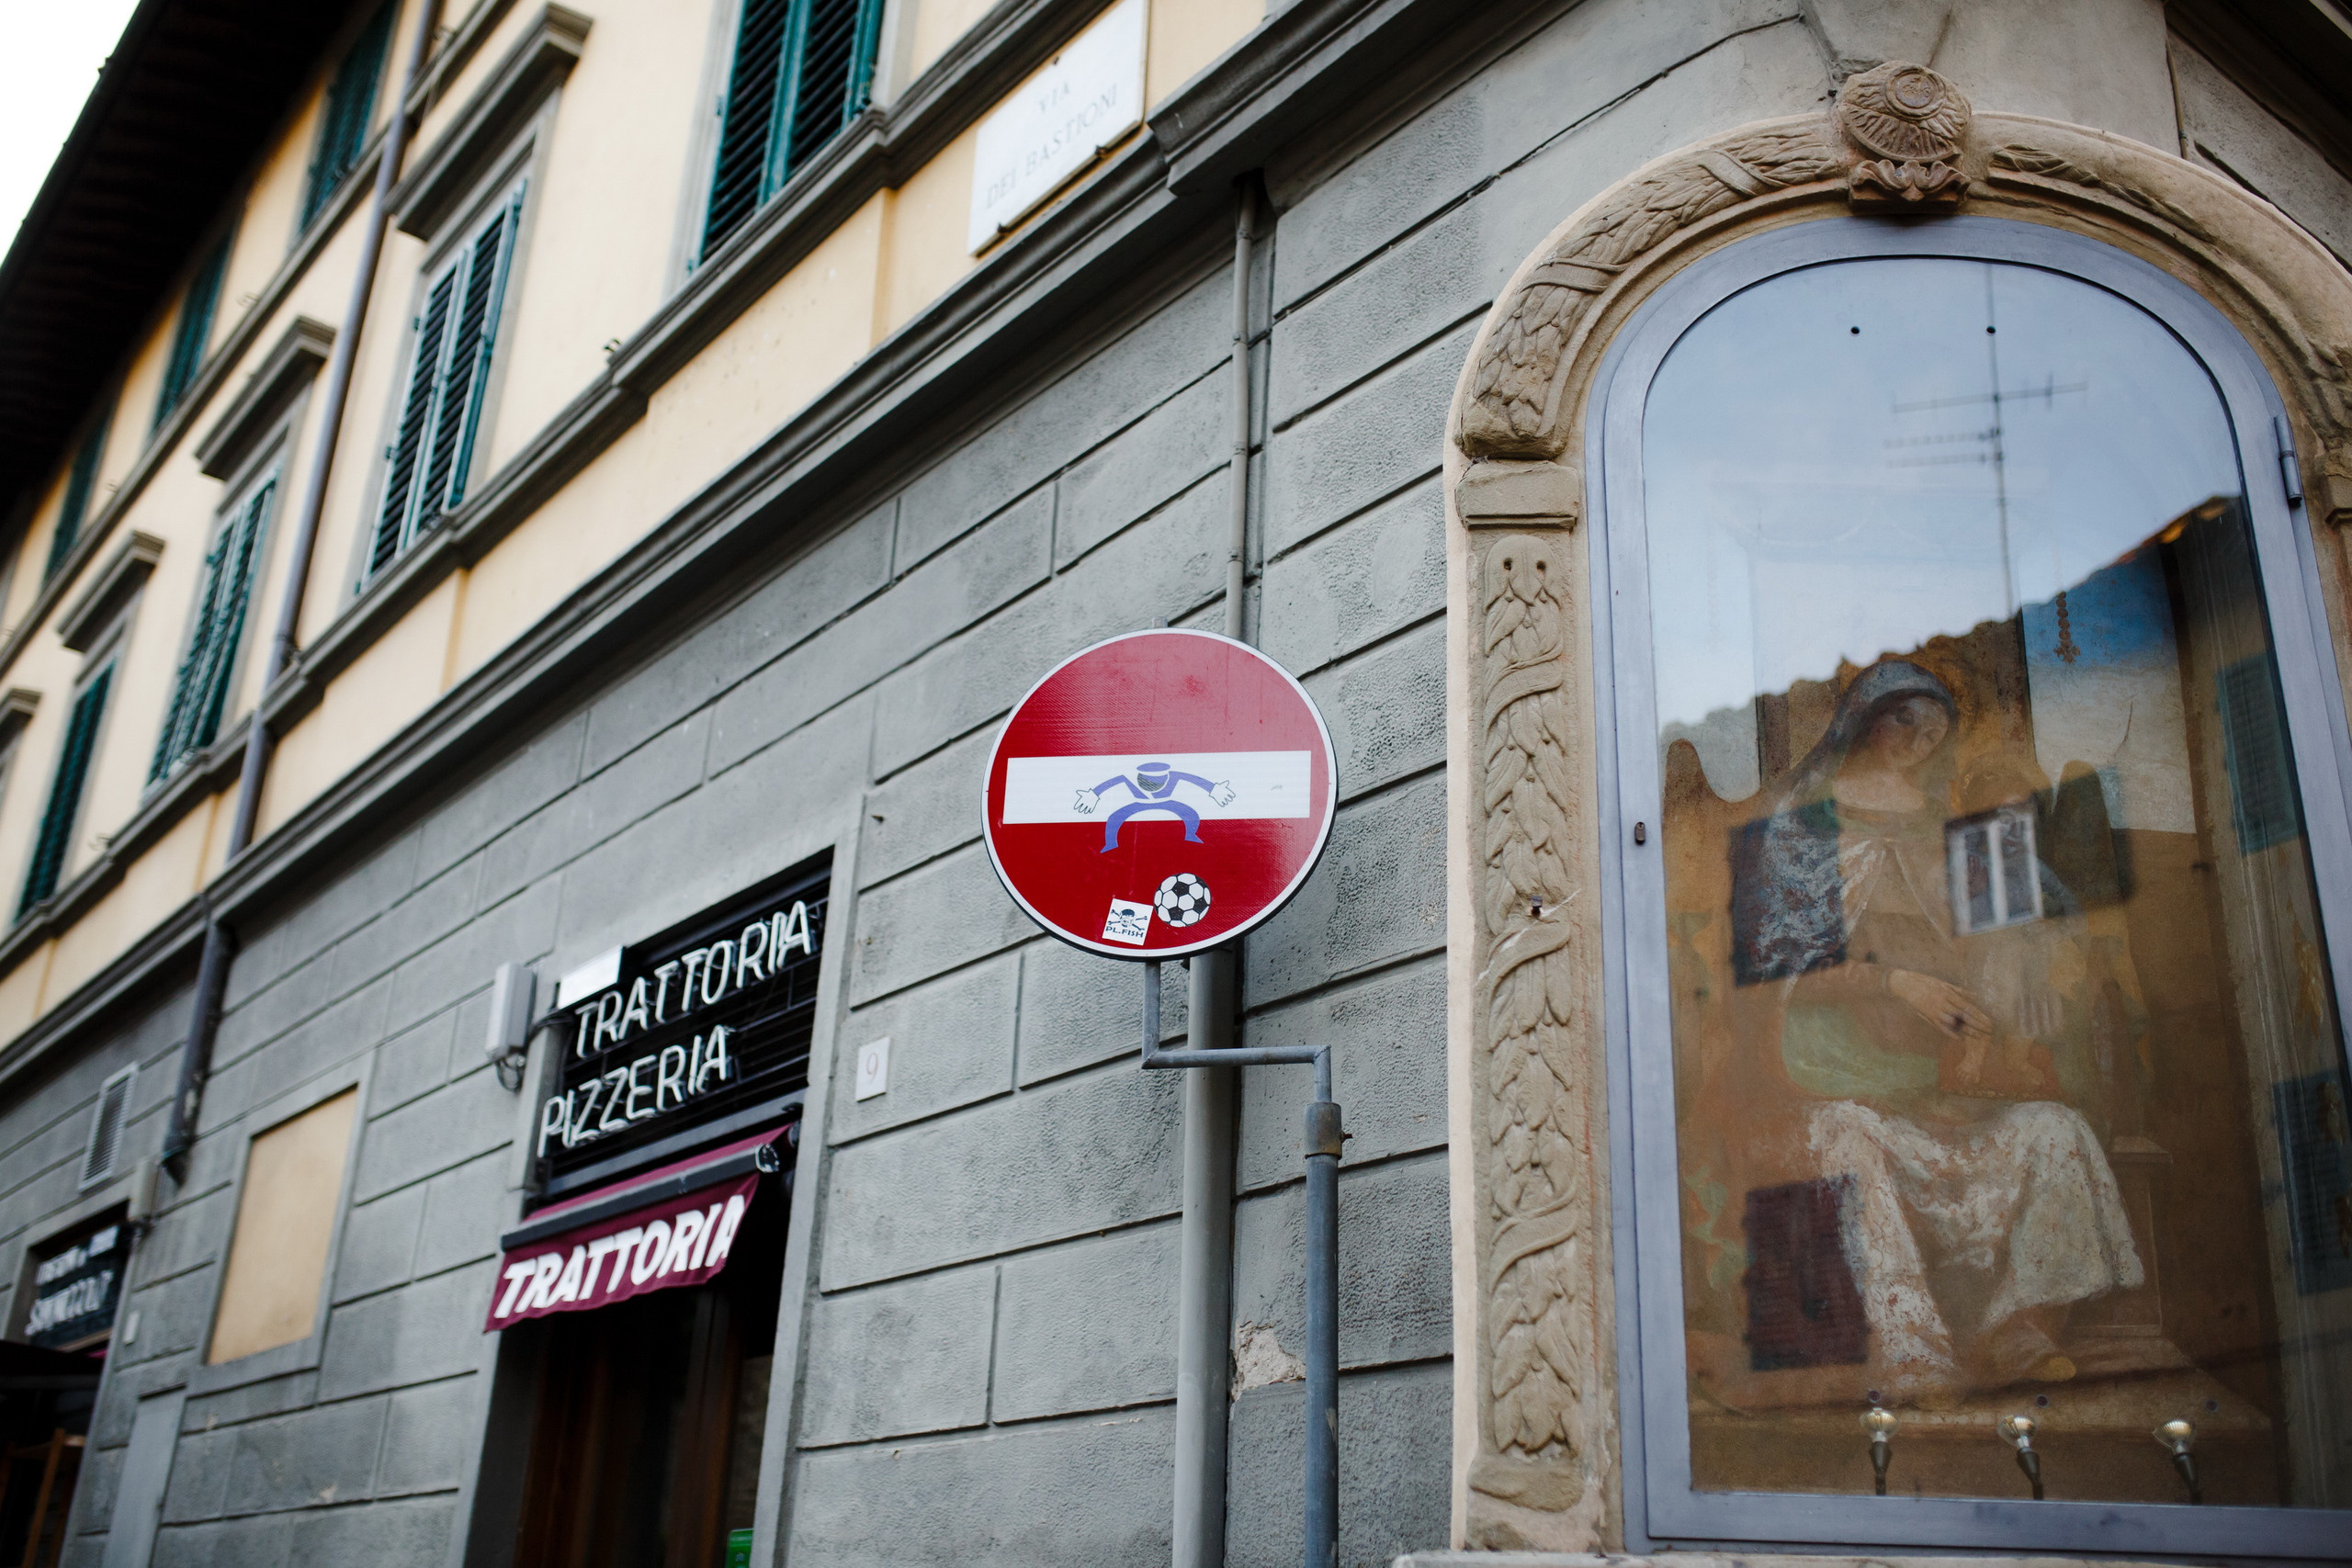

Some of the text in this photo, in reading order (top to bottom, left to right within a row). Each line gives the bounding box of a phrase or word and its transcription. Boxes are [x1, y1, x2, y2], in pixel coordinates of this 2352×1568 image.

[987, 83, 1117, 209] DEI BASTIONI
[1039, 81, 1070, 115] VIA
[575, 900, 811, 1058] TRATTORIA
[537, 1024, 729, 1157] PIZZERIA
[866, 1052, 879, 1084] 9
[493, 1194, 745, 1318] TRATTORIA
